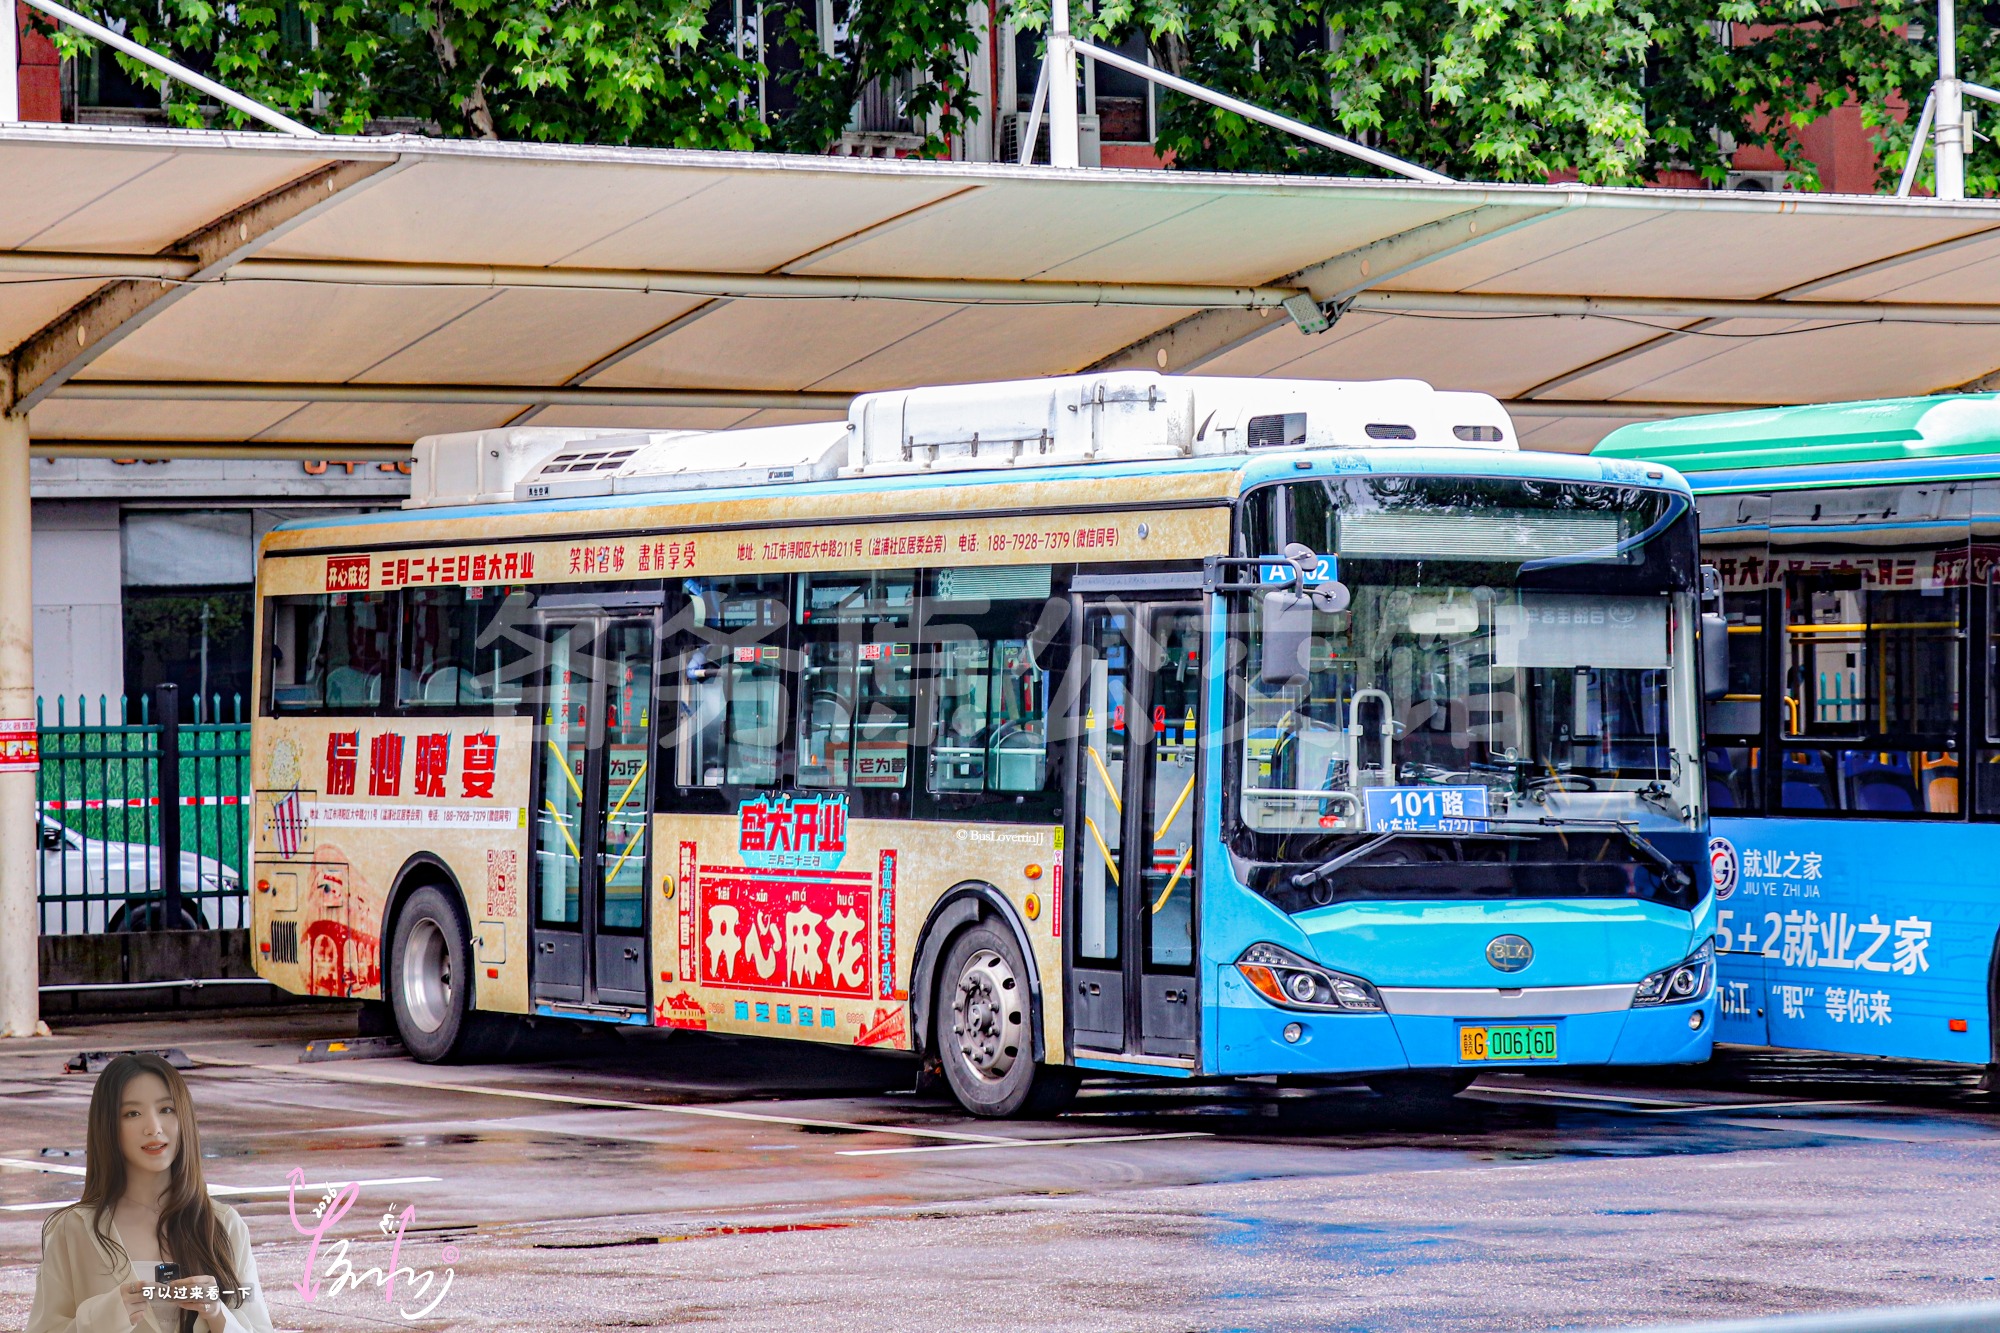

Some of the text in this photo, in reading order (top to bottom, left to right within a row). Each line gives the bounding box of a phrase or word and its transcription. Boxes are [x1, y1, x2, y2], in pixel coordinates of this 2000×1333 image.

[381, 551, 534, 586] 三月二十三日盛大开业
[569, 541, 696, 574] 笑料管够 盡情享受
[328, 565, 369, 588] 开心麻花
[740, 797, 846, 852] 盛大开业
[768, 854, 820, 866] 三月二十三日
[1743, 849, 1823, 880] 就业之家
[1743, 881, 1820, 898] JIU YE ZHI JIA
[705, 904, 866, 988] 开心麻花
[1716, 909, 1932, 975] 5+2就业之家
